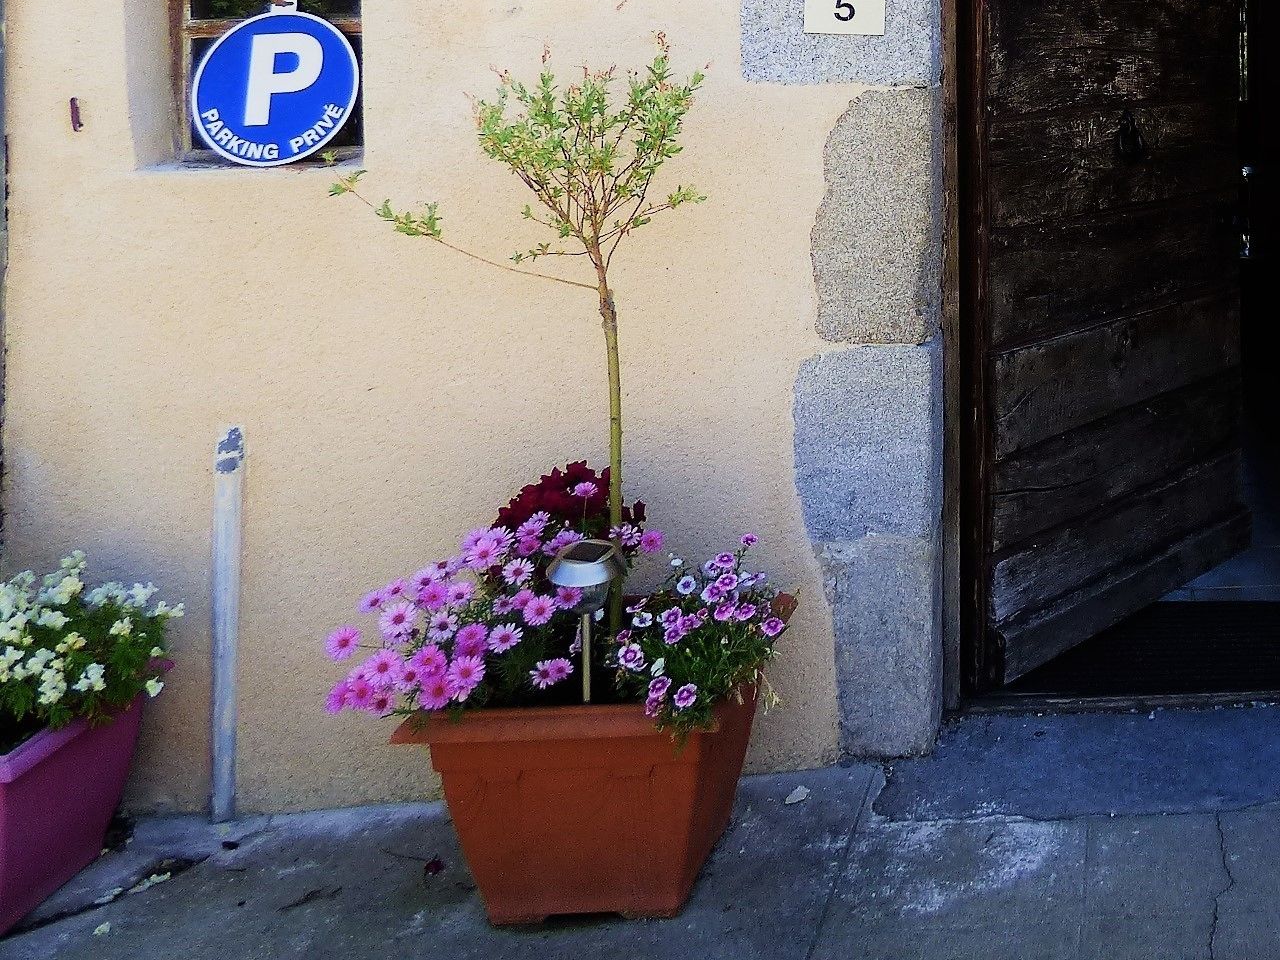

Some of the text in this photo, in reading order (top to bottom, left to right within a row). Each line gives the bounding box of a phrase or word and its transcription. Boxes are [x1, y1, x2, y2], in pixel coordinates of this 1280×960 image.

[244, 32, 324, 127] P
[201, 103, 345, 160] PARKING PRIVÉ
